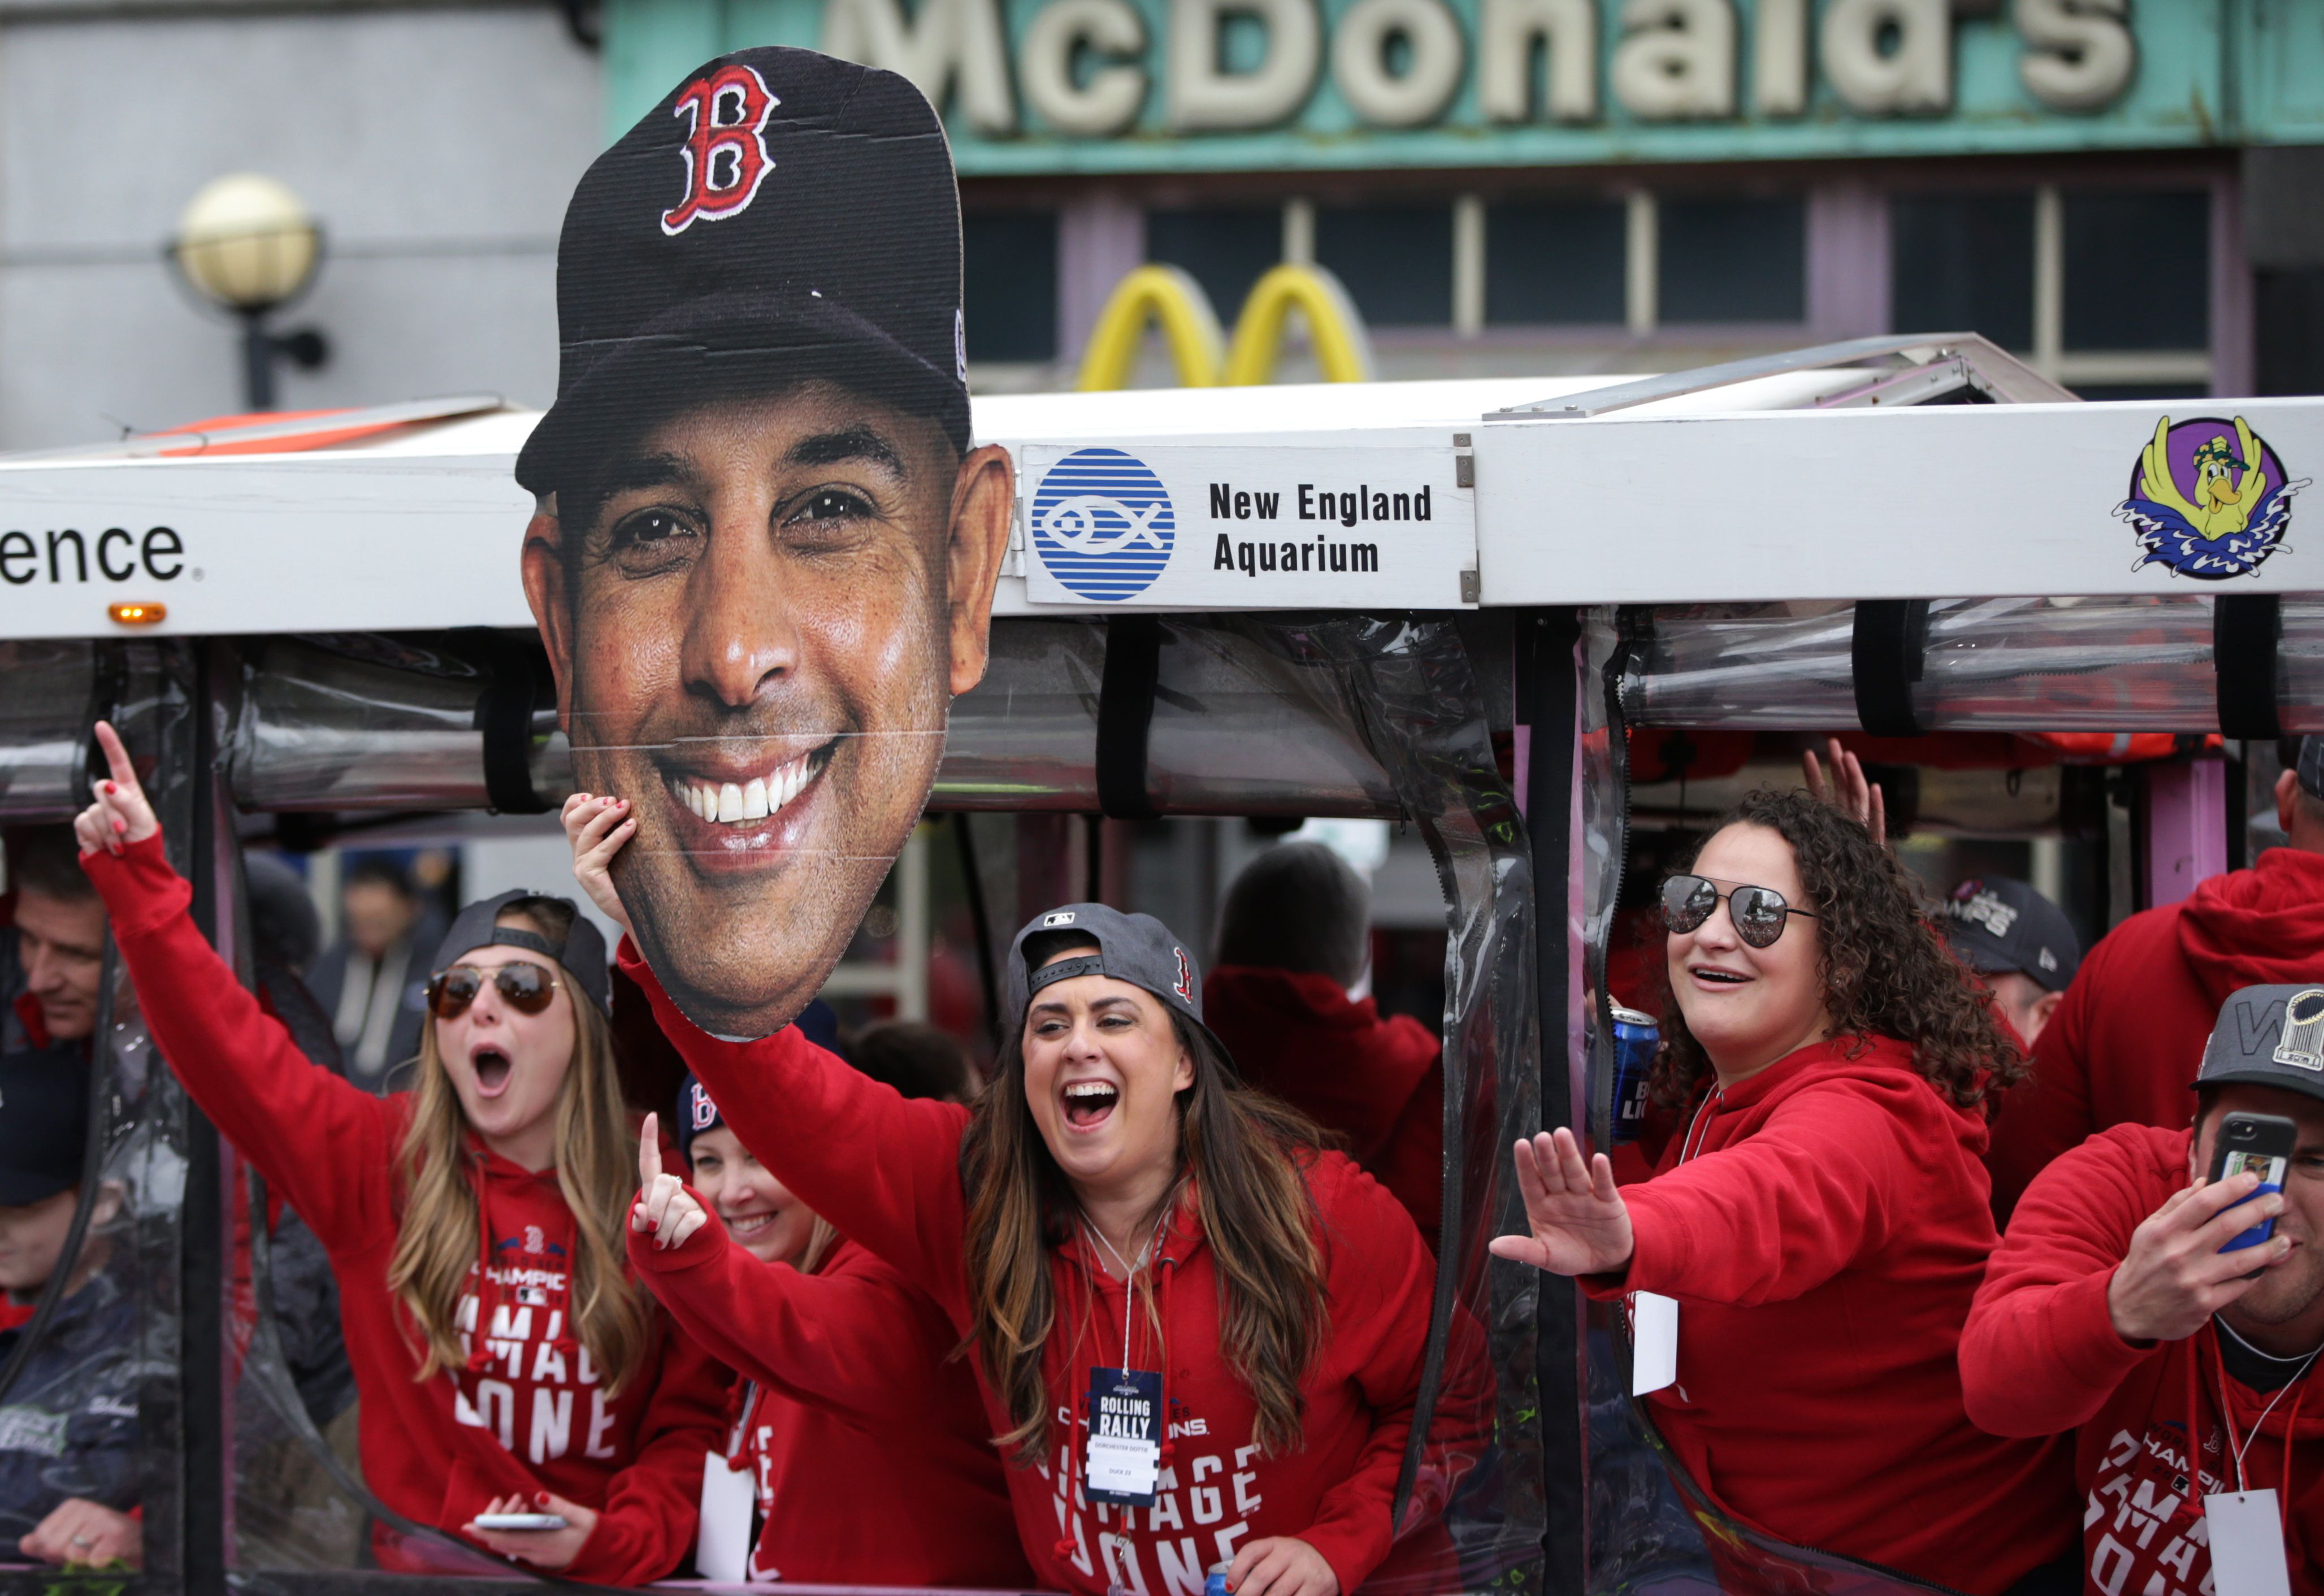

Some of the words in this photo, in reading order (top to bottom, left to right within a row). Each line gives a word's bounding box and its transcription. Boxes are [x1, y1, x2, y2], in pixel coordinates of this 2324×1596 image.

[661, 64, 781, 236] B
[1209, 483, 1280, 519] New
[1298, 484, 1432, 527] England
[1213, 533, 1378, 577] Aquarium
[1099, 1413, 1151, 1439] RALLY
[1100, 1396, 1150, 1417] ROLLING
